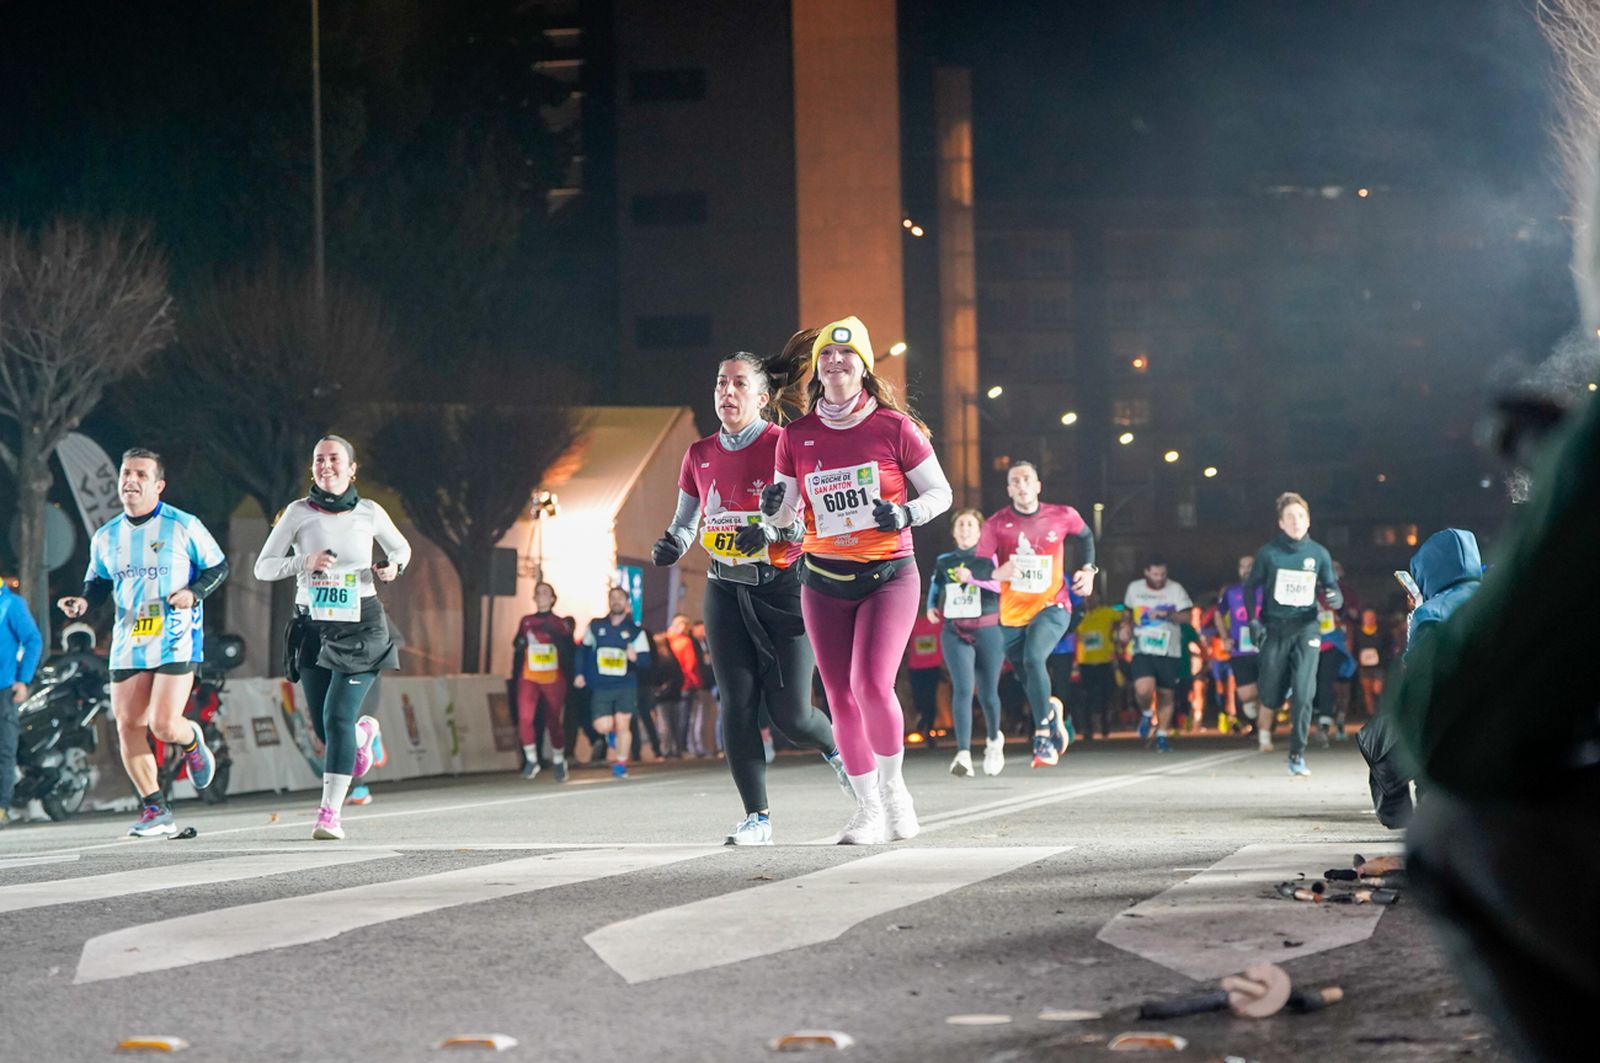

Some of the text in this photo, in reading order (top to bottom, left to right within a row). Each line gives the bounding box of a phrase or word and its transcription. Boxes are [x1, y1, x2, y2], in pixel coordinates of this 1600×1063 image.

[820, 476, 842, 485] NOCHE
[842, 474, 852, 482] DE
[814, 485, 828, 495] SAN
[823, 487, 869, 513] 6081
[715, 533, 738, 550] 67
[315, 587, 348, 603] 7786
